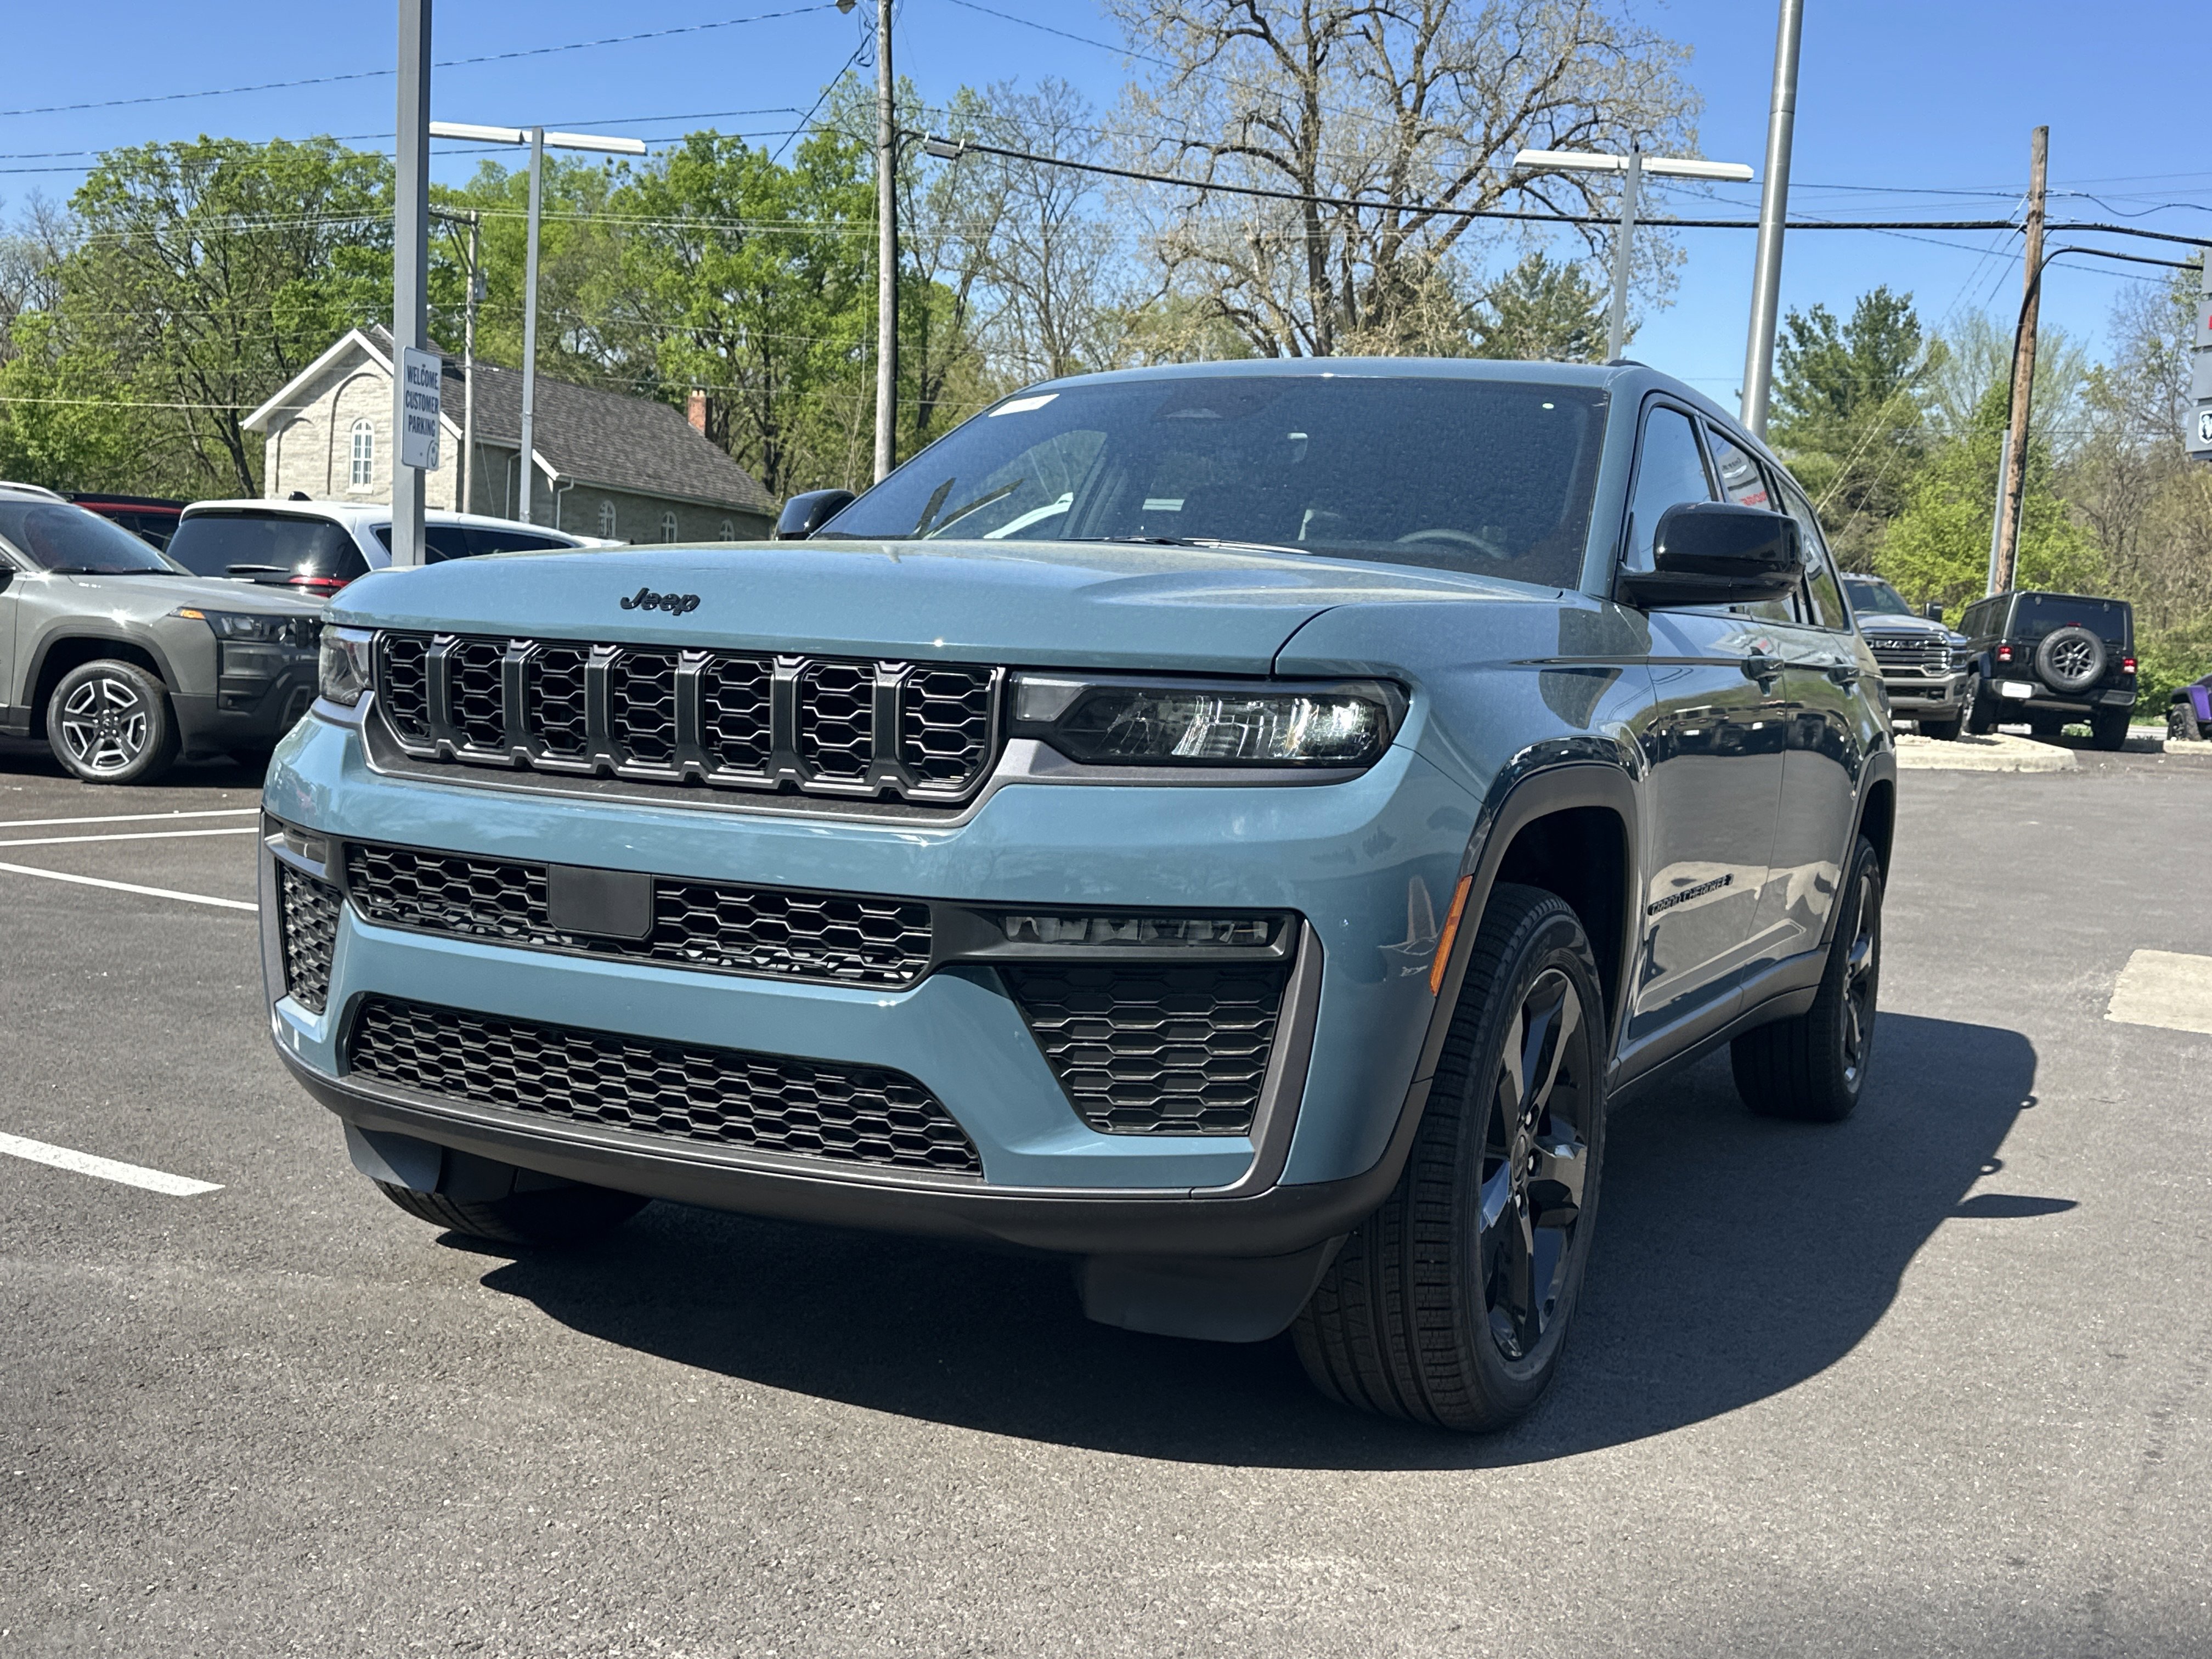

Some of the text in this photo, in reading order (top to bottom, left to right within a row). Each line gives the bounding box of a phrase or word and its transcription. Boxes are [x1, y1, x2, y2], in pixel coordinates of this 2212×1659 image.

[407, 364, 438, 390] WELCOME
[405, 390, 439, 415] CUSTOMER
[408, 414, 436, 437] PARKING
[620, 587, 701, 616] Jeep
